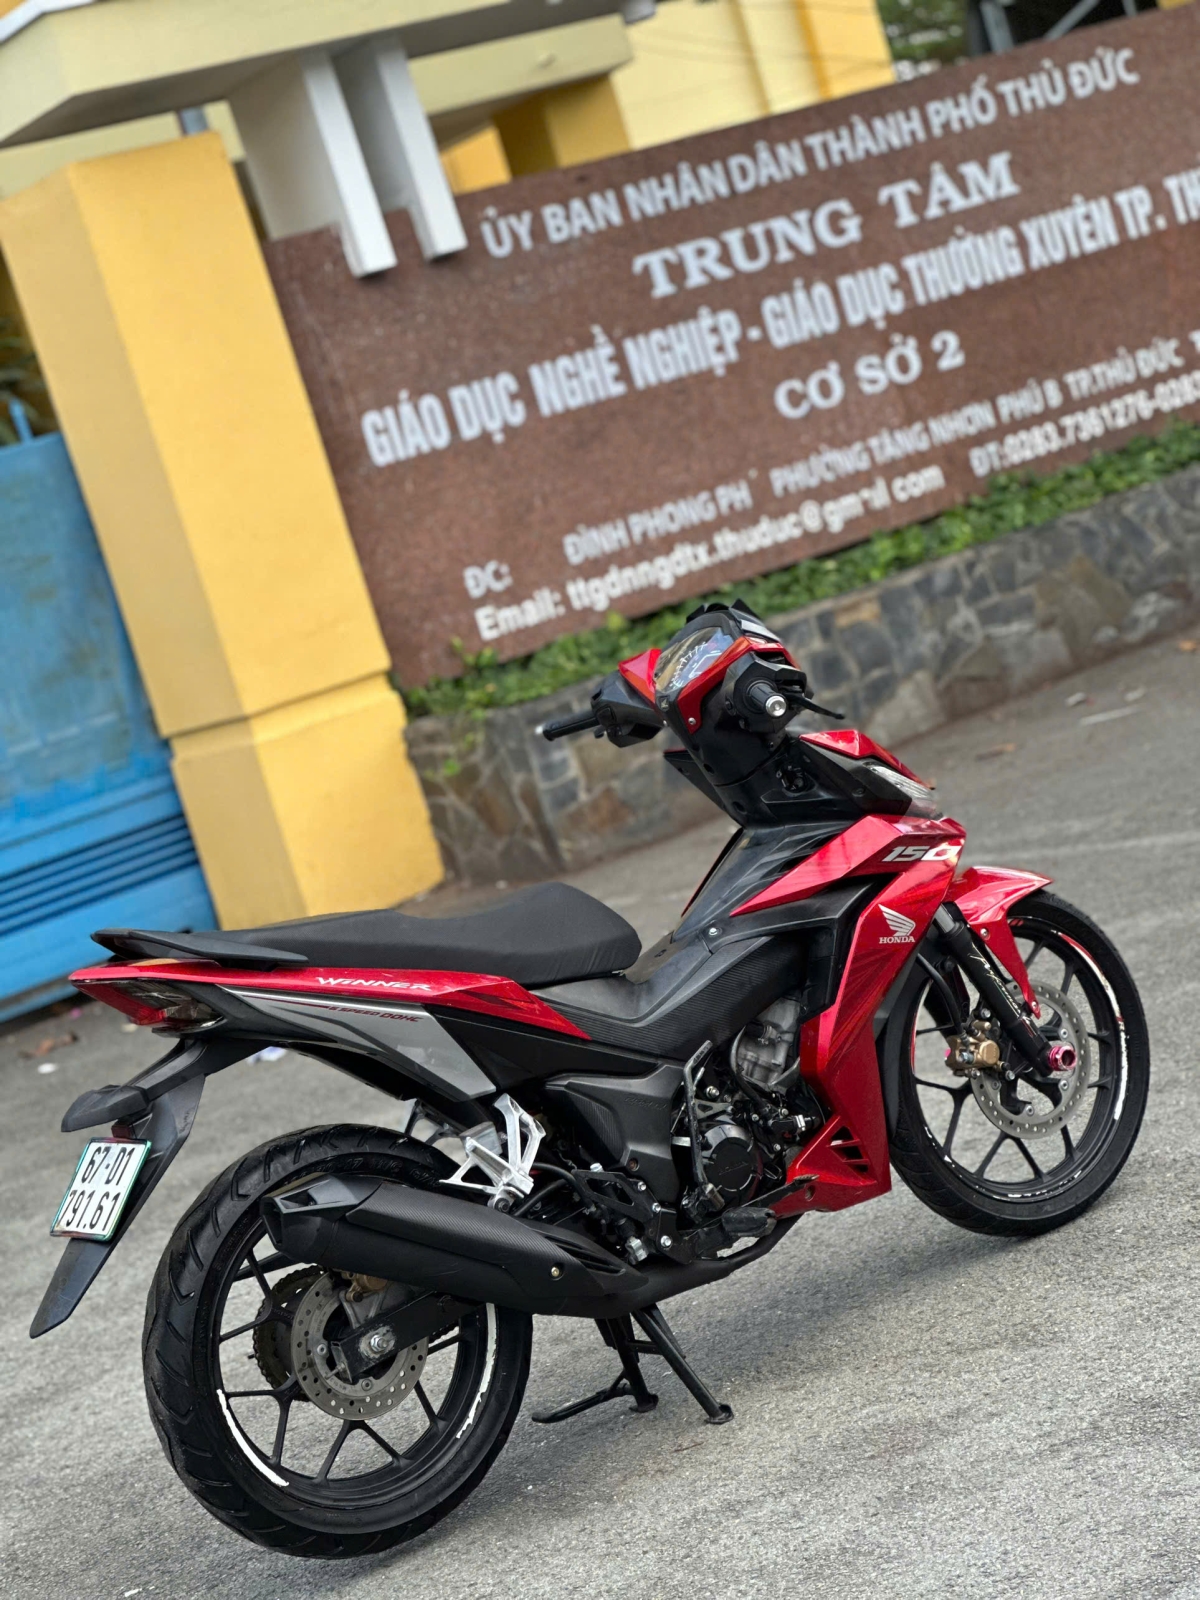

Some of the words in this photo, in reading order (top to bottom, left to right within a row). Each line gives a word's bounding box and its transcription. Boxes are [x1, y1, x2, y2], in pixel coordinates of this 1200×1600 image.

[480, 206, 533, 258] ỦY
[542, 189, 622, 243] BAN
[623, 162, 732, 221] NHÂN
[728, 141, 807, 193] DÂN
[805, 114, 927, 170] THÀNH
[926, 74, 999, 138] PHỐ
[996, 58, 1066, 117] THỦ
[1067, 46, 1140, 99] ĐỨC
[632, 199, 863, 298] TRUNG
[878, 151, 1021, 228] TÂM
[361, 389, 451, 467] GIÁO
[448, 371, 527, 444] DỤC
[529, 324, 627, 418] NGHỀ
[623, 305, 742, 390] NGHIỆP
[761, 277, 841, 349] GIÁO
[836, 262, 905, 330] DỤC
[902, 225, 1026, 306] THƯỜNG
[1019, 193, 1120, 271] XUYÊN
[1113, 185, 1168, 240] TP.
[773, 360, 845, 419] CƠ
[854, 333, 923, 395] SỞ
[930, 330, 966, 371] 2
[627, 490, 718, 545] PHONG
[474, 588, 566, 641] Email:
[881, 845, 962, 862] 150
[879, 936, 916, 944] HONDA
[316, 976, 432, 992] WINNER
[338, 1007, 381, 1017] SPEED
[55, 1189, 121, 1231] 791.61
